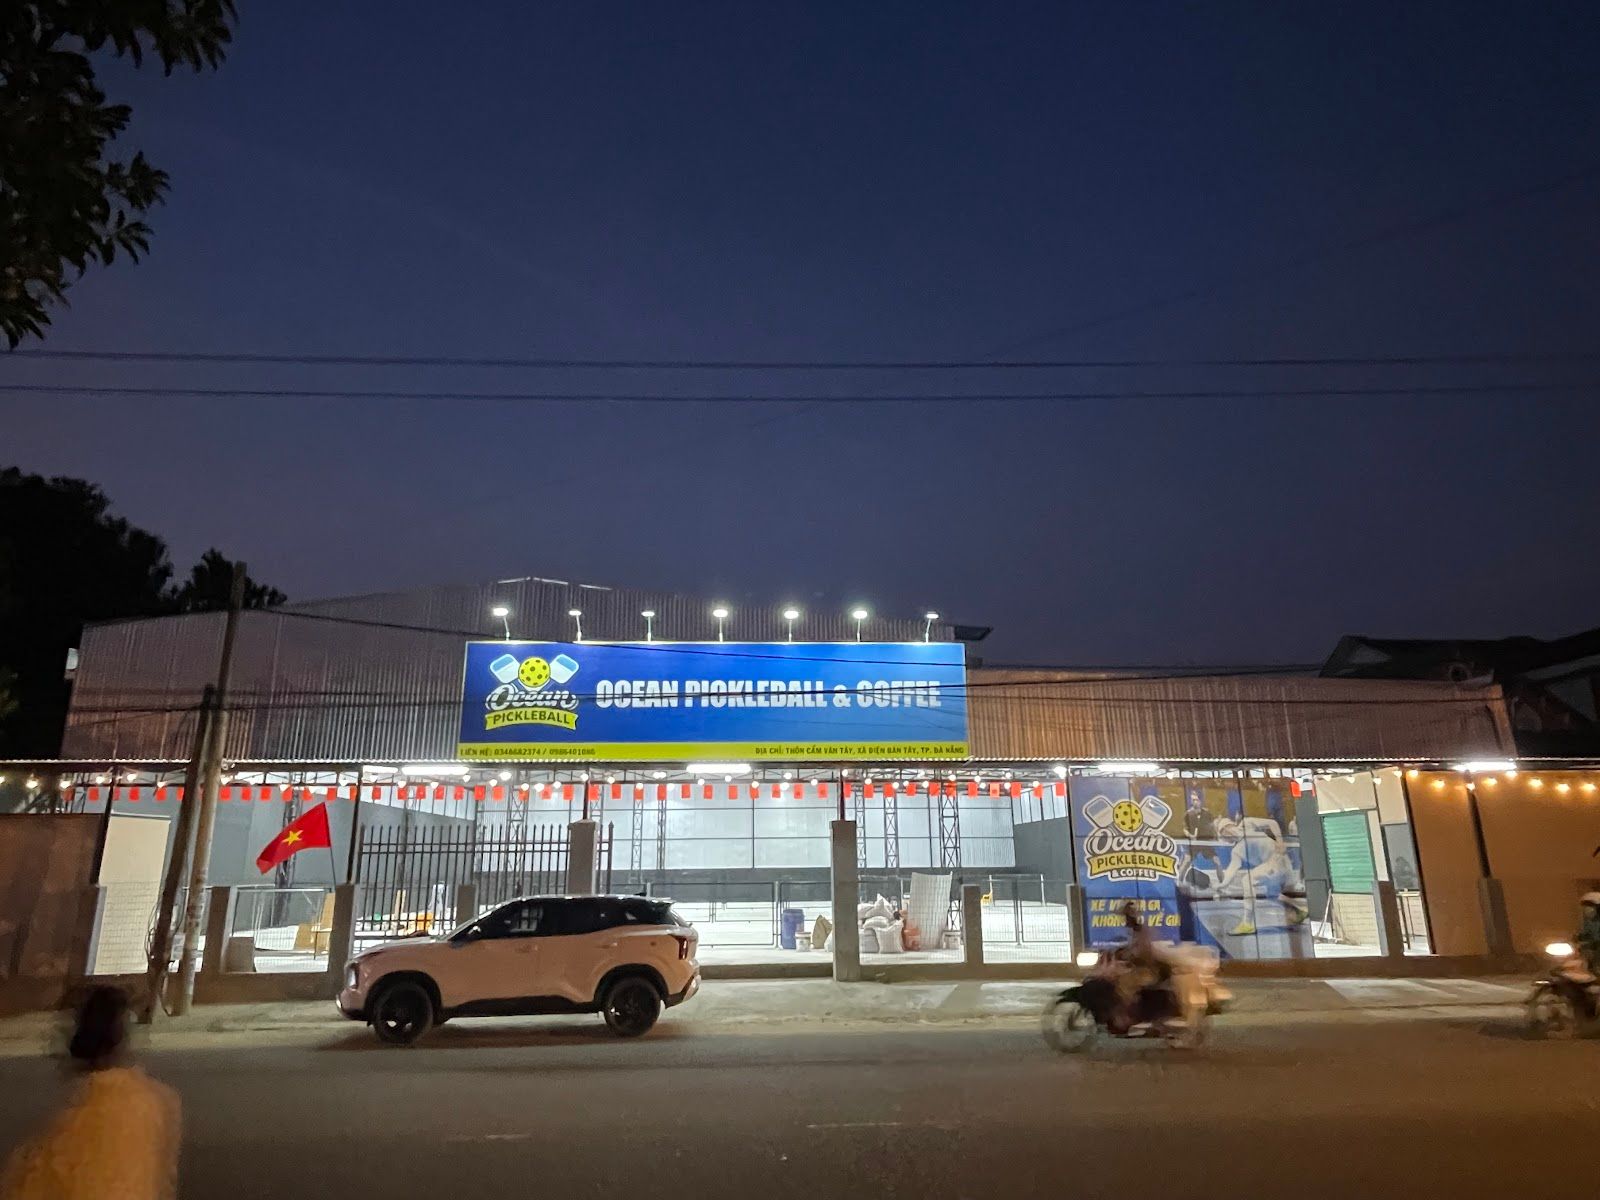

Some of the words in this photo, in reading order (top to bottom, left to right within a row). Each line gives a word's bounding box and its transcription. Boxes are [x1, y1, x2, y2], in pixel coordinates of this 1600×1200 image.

[488, 684, 577, 710] Ocean
[596, 680, 679, 708] OCEAN
[684, 680, 828, 708] PICKLEBALL
[832, 684, 850, 708] &
[856, 680, 942, 708] COFFEE
[493, 710, 570, 725] PICKLEBALL
[786, 746, 805, 755] THÔN
[1091, 828, 1172, 855] Ocean
[1096, 854, 1168, 869] PICKLEBALL
[1111, 869, 1120, 878] &
[1120, 868, 1156, 878] COFFEE
